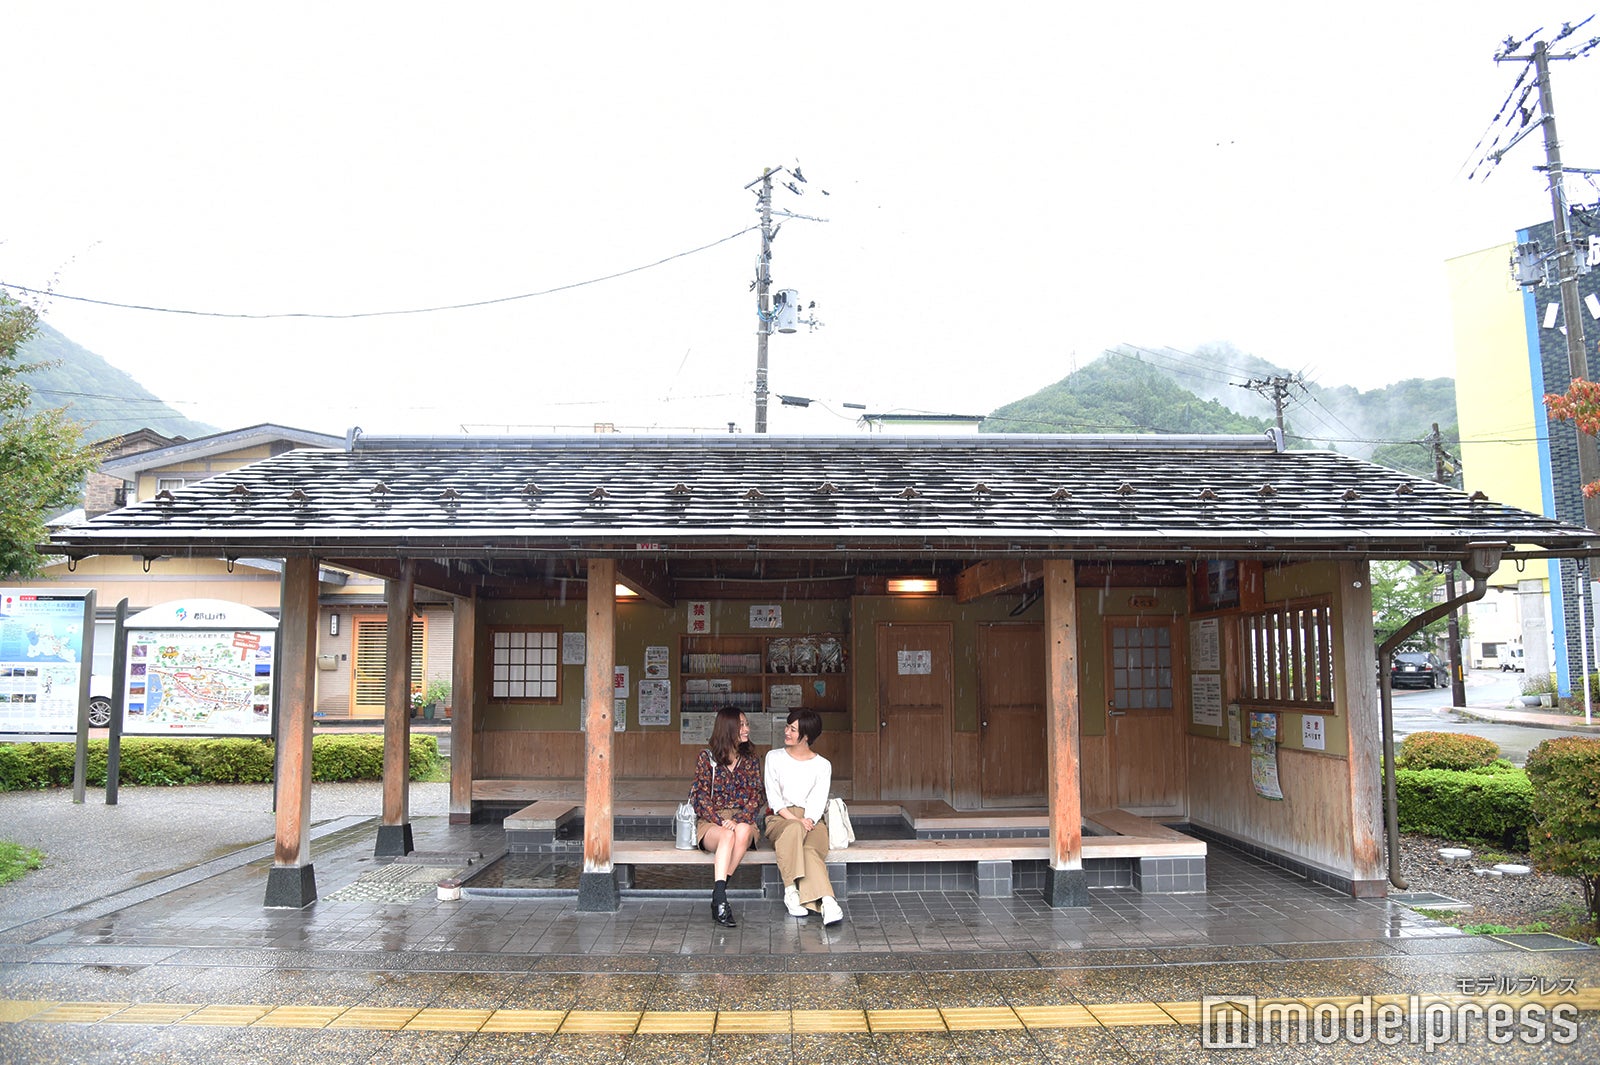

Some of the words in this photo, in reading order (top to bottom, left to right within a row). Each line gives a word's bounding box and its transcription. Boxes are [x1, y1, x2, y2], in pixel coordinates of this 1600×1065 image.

[194, 612, 226, 621] 郡山市
[693, 604, 705, 631] 禁煙
